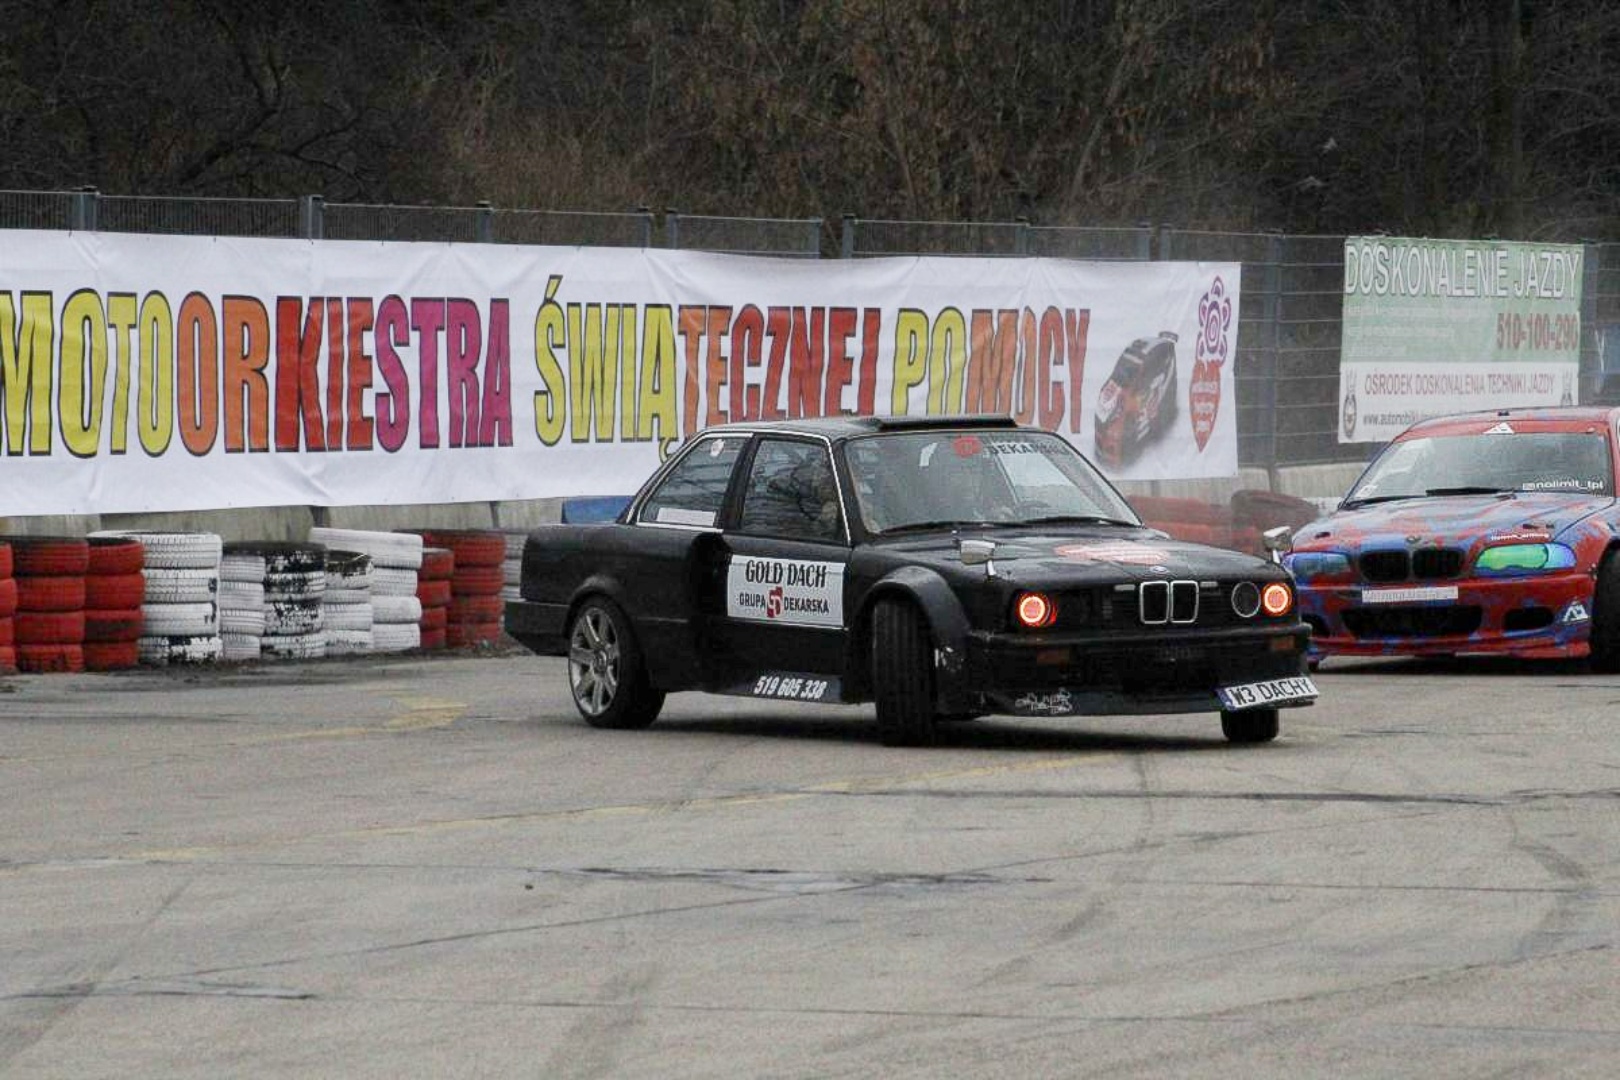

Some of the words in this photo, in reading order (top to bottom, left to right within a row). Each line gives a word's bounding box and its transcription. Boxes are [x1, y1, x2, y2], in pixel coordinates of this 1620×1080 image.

[1345, 242, 1509, 298] DOSKONALENIE
[1514, 251, 1580, 299] JAZDY
[0, 287, 513, 459] MOTOORKIESTRA
[533, 274, 881, 463] ŚWIĄTECZNEJ
[891, 305, 1091, 435] POMOCY
[1364, 370, 1412, 395] OŚRODEK
[1415, 373, 1485, 395] DOSKONALENIA
[1487, 373, 1525, 395] TECHNIKI
[1527, 373, 1555, 395] JAZDY
[745, 559, 783, 584] GOLD
[787, 562, 827, 588] DACH
[739, 591, 766, 608] GRUPA
[784, 596, 830, 615] DEKARSKA
[753, 675, 780, 695] 519
[777, 677, 804, 697] 605
[1229, 686, 1257, 706] W3
[1256, 678, 1313, 700] DACHY
